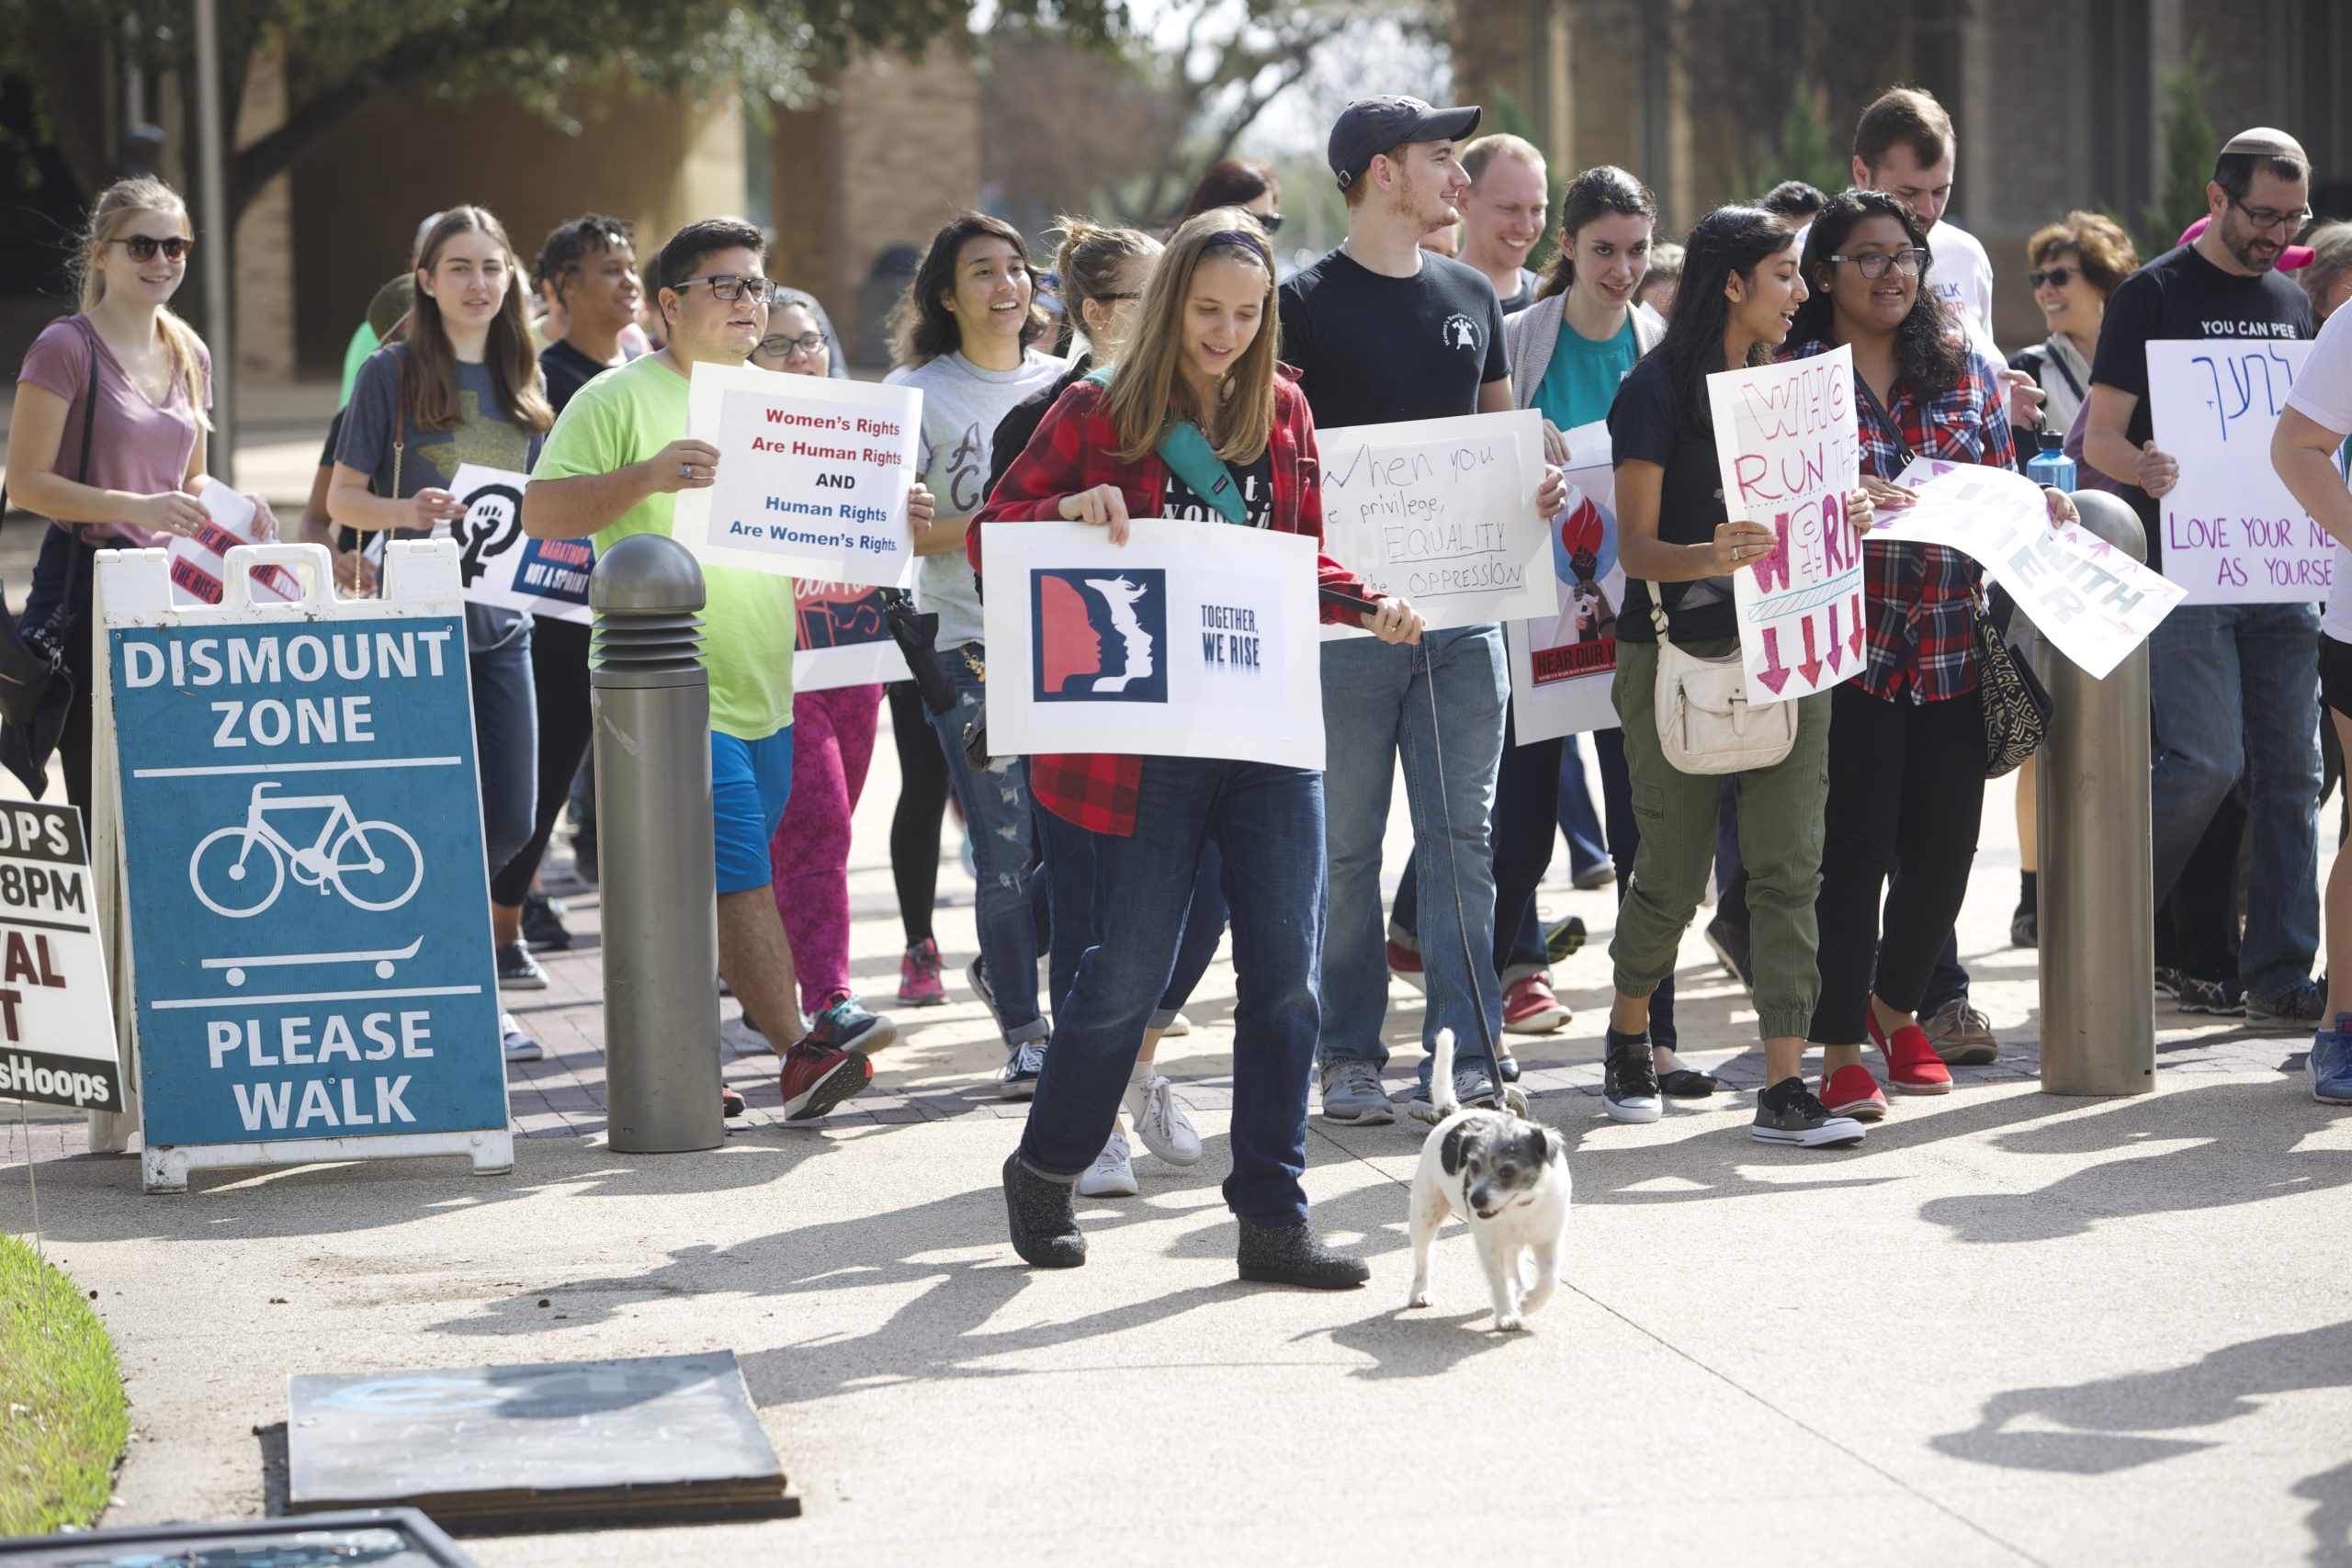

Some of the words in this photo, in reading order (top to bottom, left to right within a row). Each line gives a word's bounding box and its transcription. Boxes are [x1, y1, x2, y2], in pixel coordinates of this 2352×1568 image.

[2201, 321, 2234, 335] YOU
[2238, 321, 2268, 337] CAN
[2270, 322, 2296, 339] PEE
[1742, 364, 1848, 441] WHO
[765, 408, 851, 431] Women's
[856, 418, 900, 437] Rights
[752, 436, 786, 453] Are
[792, 441, 856, 461] Human
[863, 448, 902, 468] Rights
[1322, 443, 1432, 488] When
[1450, 446, 1495, 483] you
[1734, 442, 1825, 502] RUN
[1832, 433, 1858, 487] THE
[816, 472, 855, 490] AND
[765, 496, 832, 517] Human
[839, 503, 887, 524] Rights
[1360, 491, 1445, 524] privilege,
[198, 525, 219, 546] HE
[729, 520, 763, 537] Are
[770, 525, 854, 548] Women's
[859, 536, 898, 555] Rights.
[1385, 523, 1505, 558] EQUALITY
[2169, 512, 2231, 549] LOVE
[2241, 517, 2294, 548] YOUR
[173, 561, 195, 587] THE
[191, 572, 218, 601] RISE
[524, 562, 548, 586] NOT
[542, 567, 554, 588] A
[552, 569, 589, 595] SPRINT
[1409, 555, 1521, 591] OPPRESSION
[2035, 530, 2145, 615] WITH
[2218, 557, 2248, 587] AS
[1201, 604, 1259, 635] TOGETHER,
[123, 630, 451, 688] DISMOUNT
[1202, 632, 1225, 662] WE
[1230, 635, 1260, 667] RISE
[1536, 649, 1572, 677] HEAR
[1576, 644, 1603, 667] OUR
[211, 695, 376, 748] ZONE
[1, 864, 86, 914] 8PM
[207, 1011, 435, 1069] PLEASE
[0, 1055, 110, 1107] sHoops
[233, 1076, 417, 1131] WALK
